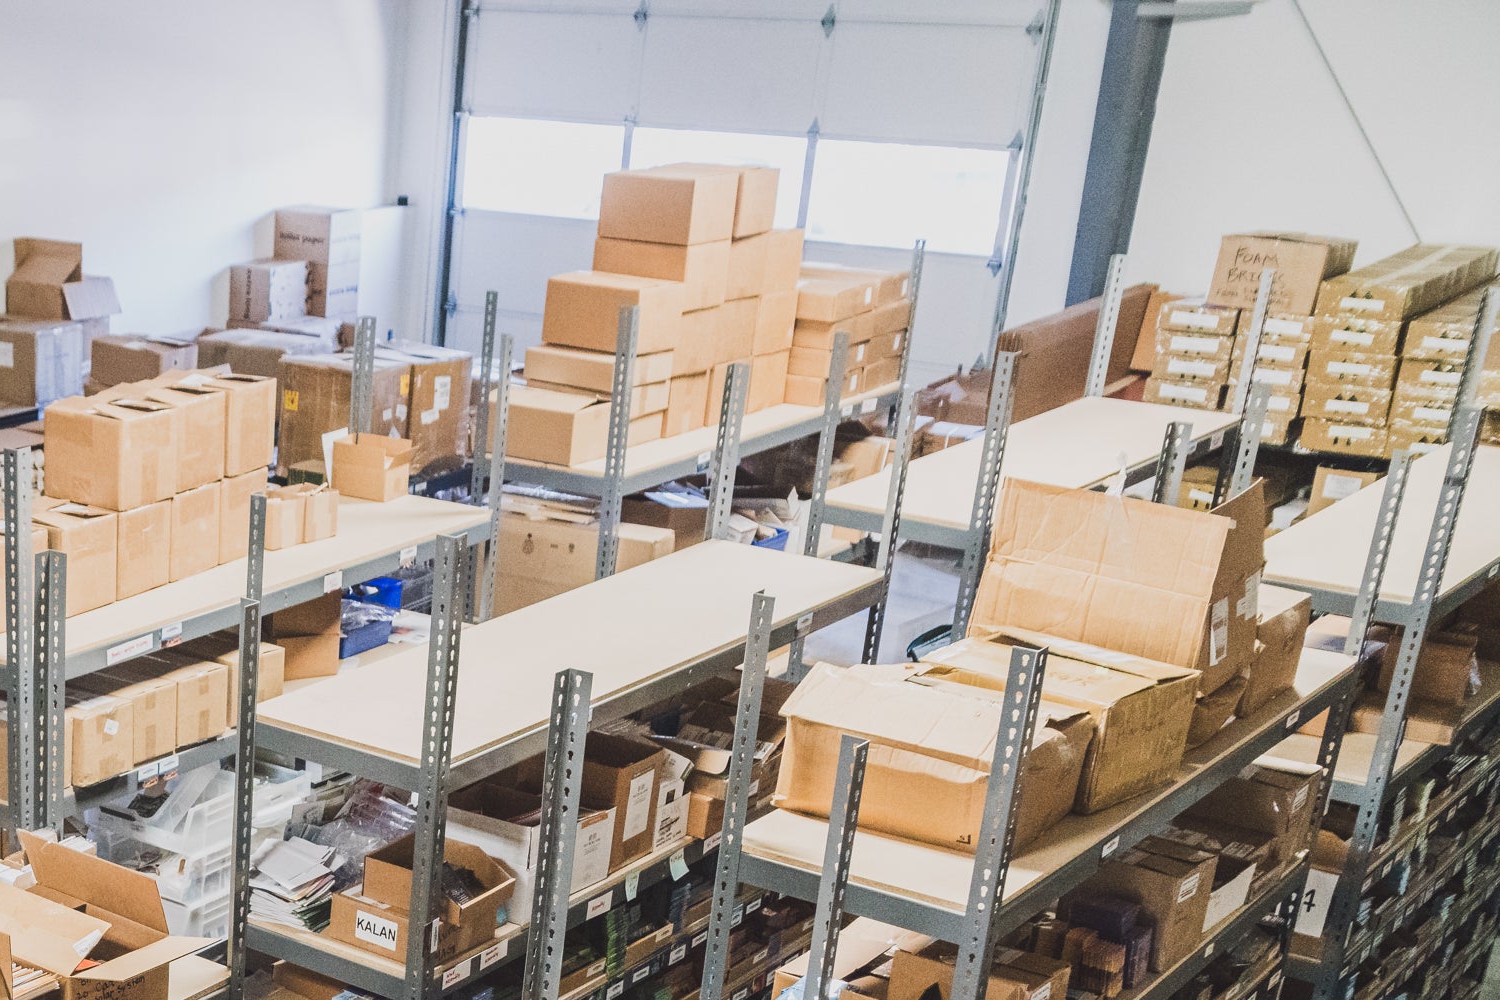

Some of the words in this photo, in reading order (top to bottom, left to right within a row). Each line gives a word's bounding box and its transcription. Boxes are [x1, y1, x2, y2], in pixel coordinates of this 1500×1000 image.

[1233, 247, 1279, 267] FOAM
[1303, 889, 1316, 913] 4
[357, 917, 396, 942] KALAN
